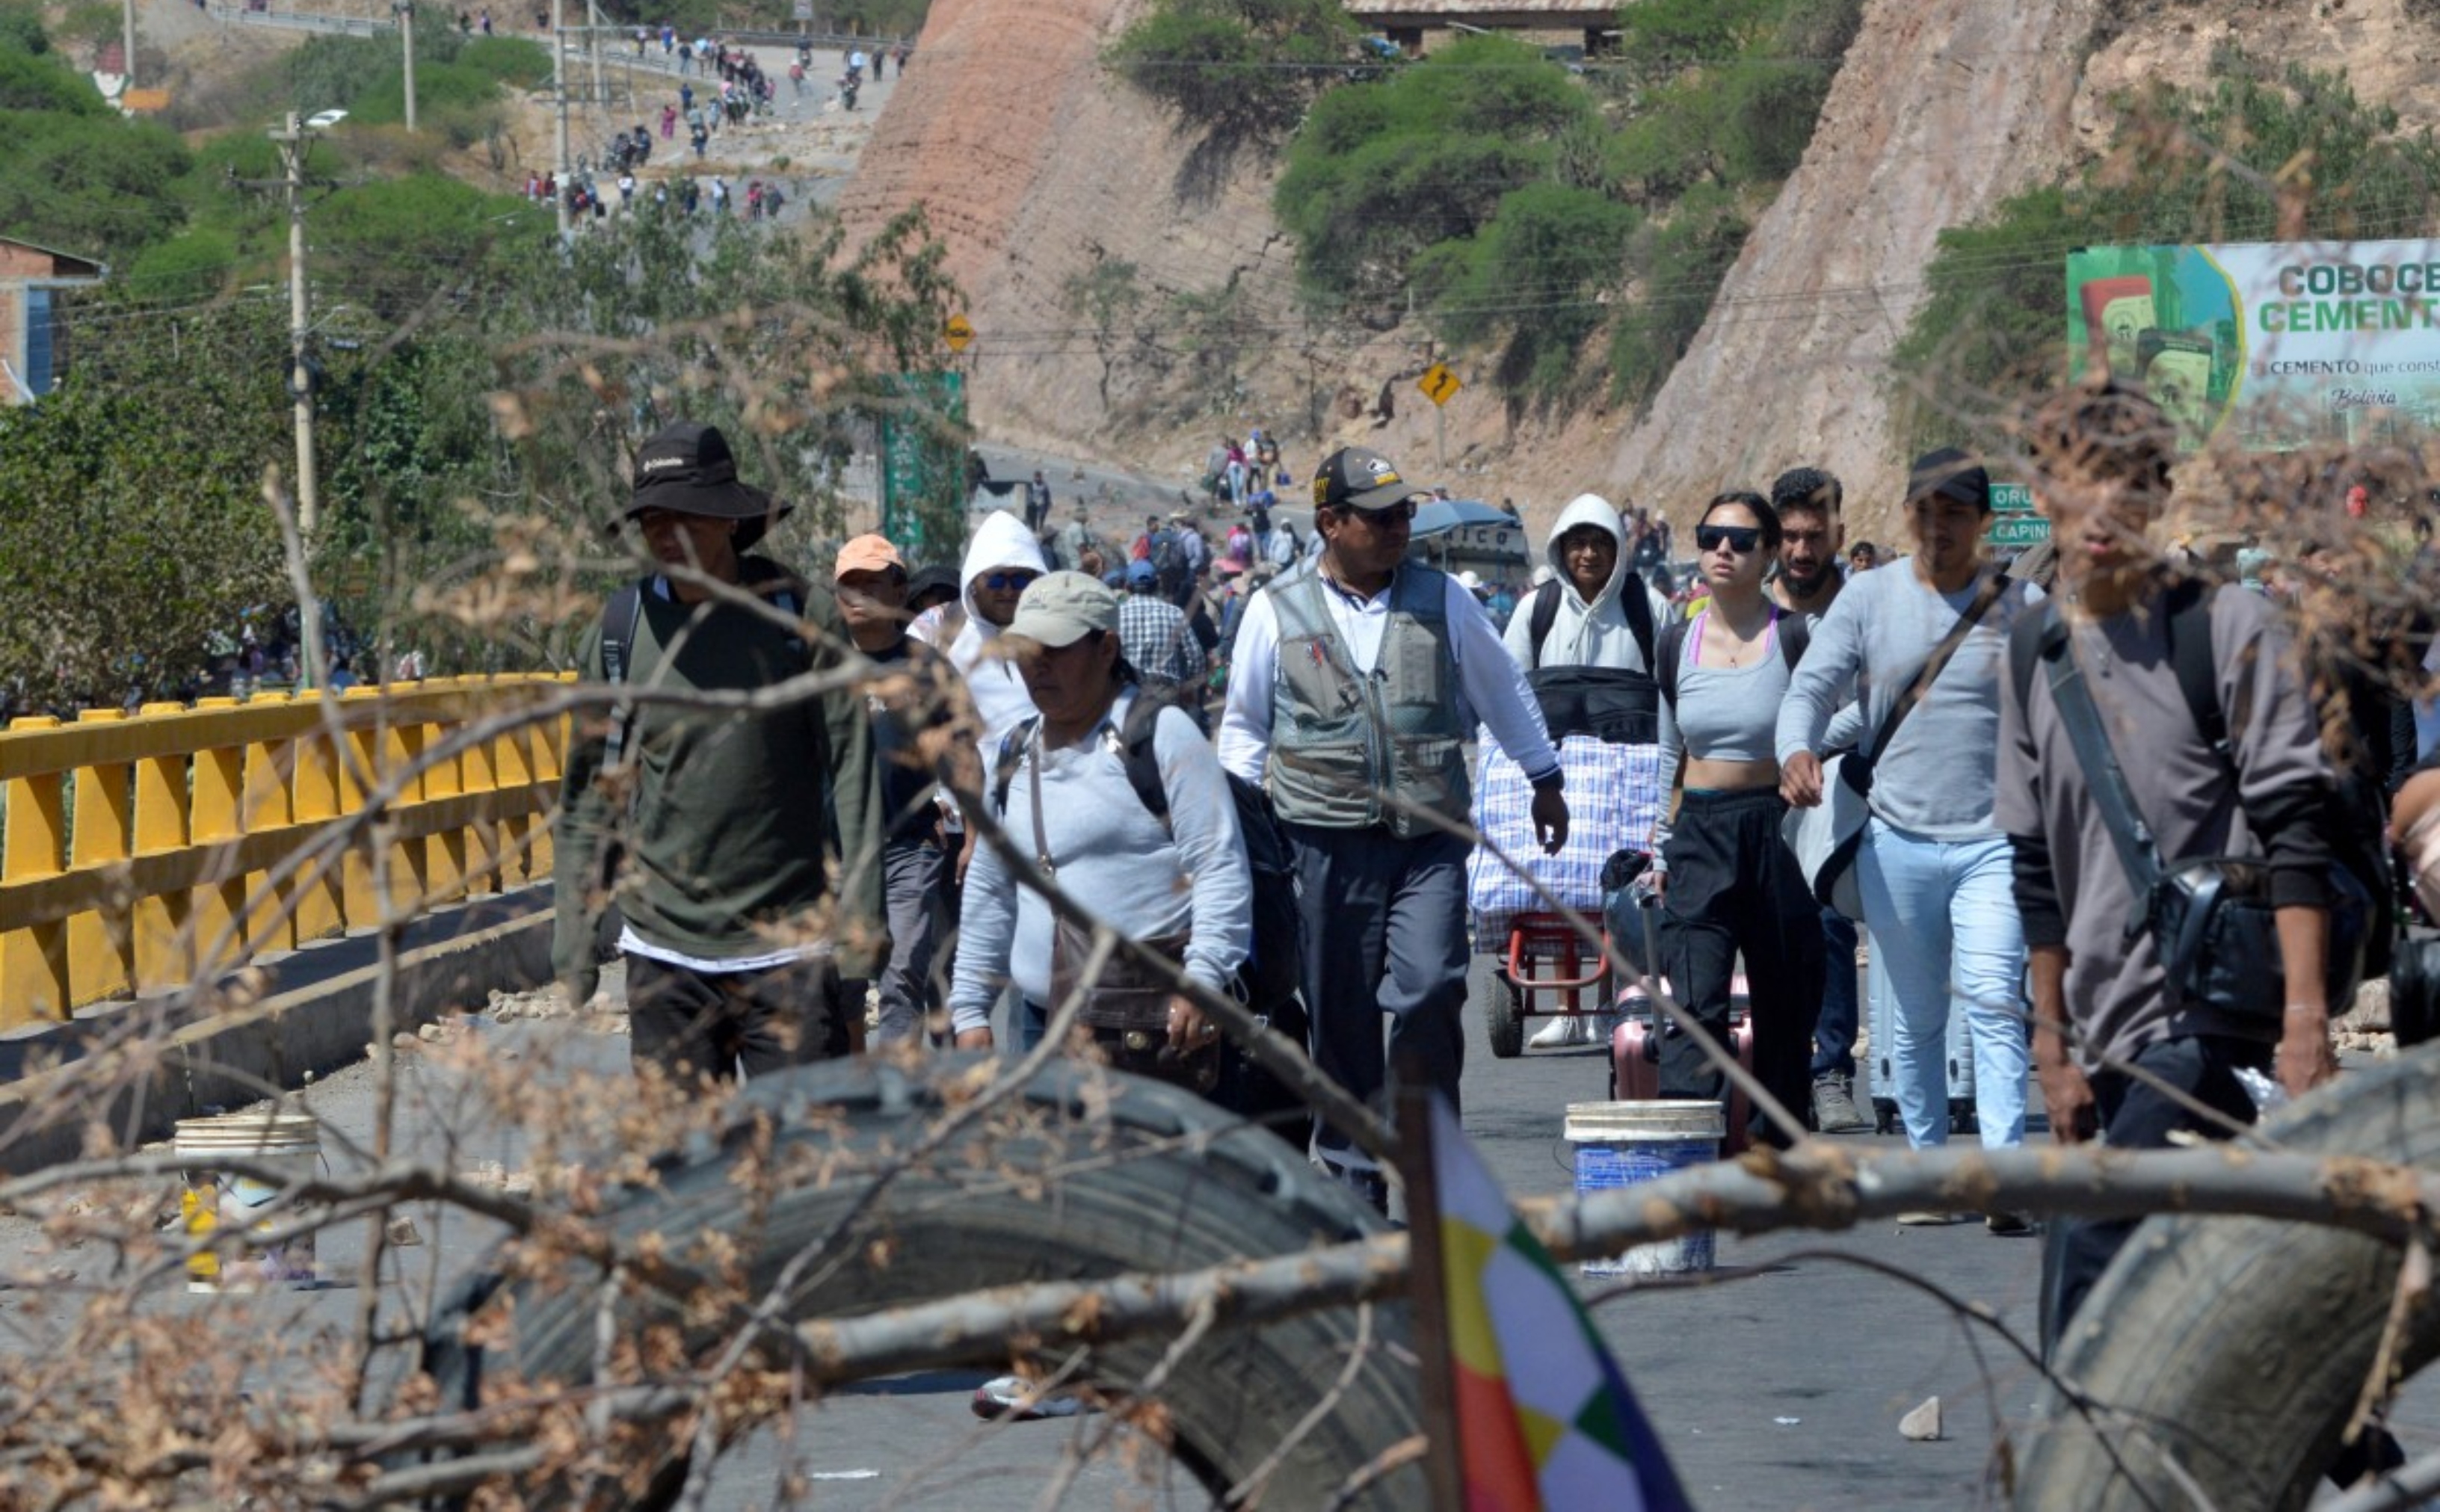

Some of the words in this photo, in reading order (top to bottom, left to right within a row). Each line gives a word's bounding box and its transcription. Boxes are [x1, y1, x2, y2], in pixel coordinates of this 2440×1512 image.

[2279, 263, 2440, 295] COBOCE
[2259, 298, 2439, 332] CEMENT
[2270, 360, 2359, 374] CEMENTO
[2364, 362, 2394, 377] que
[2332, 388, 2397, 408] Bolivia
[1997, 524, 2051, 538] CAPIN
